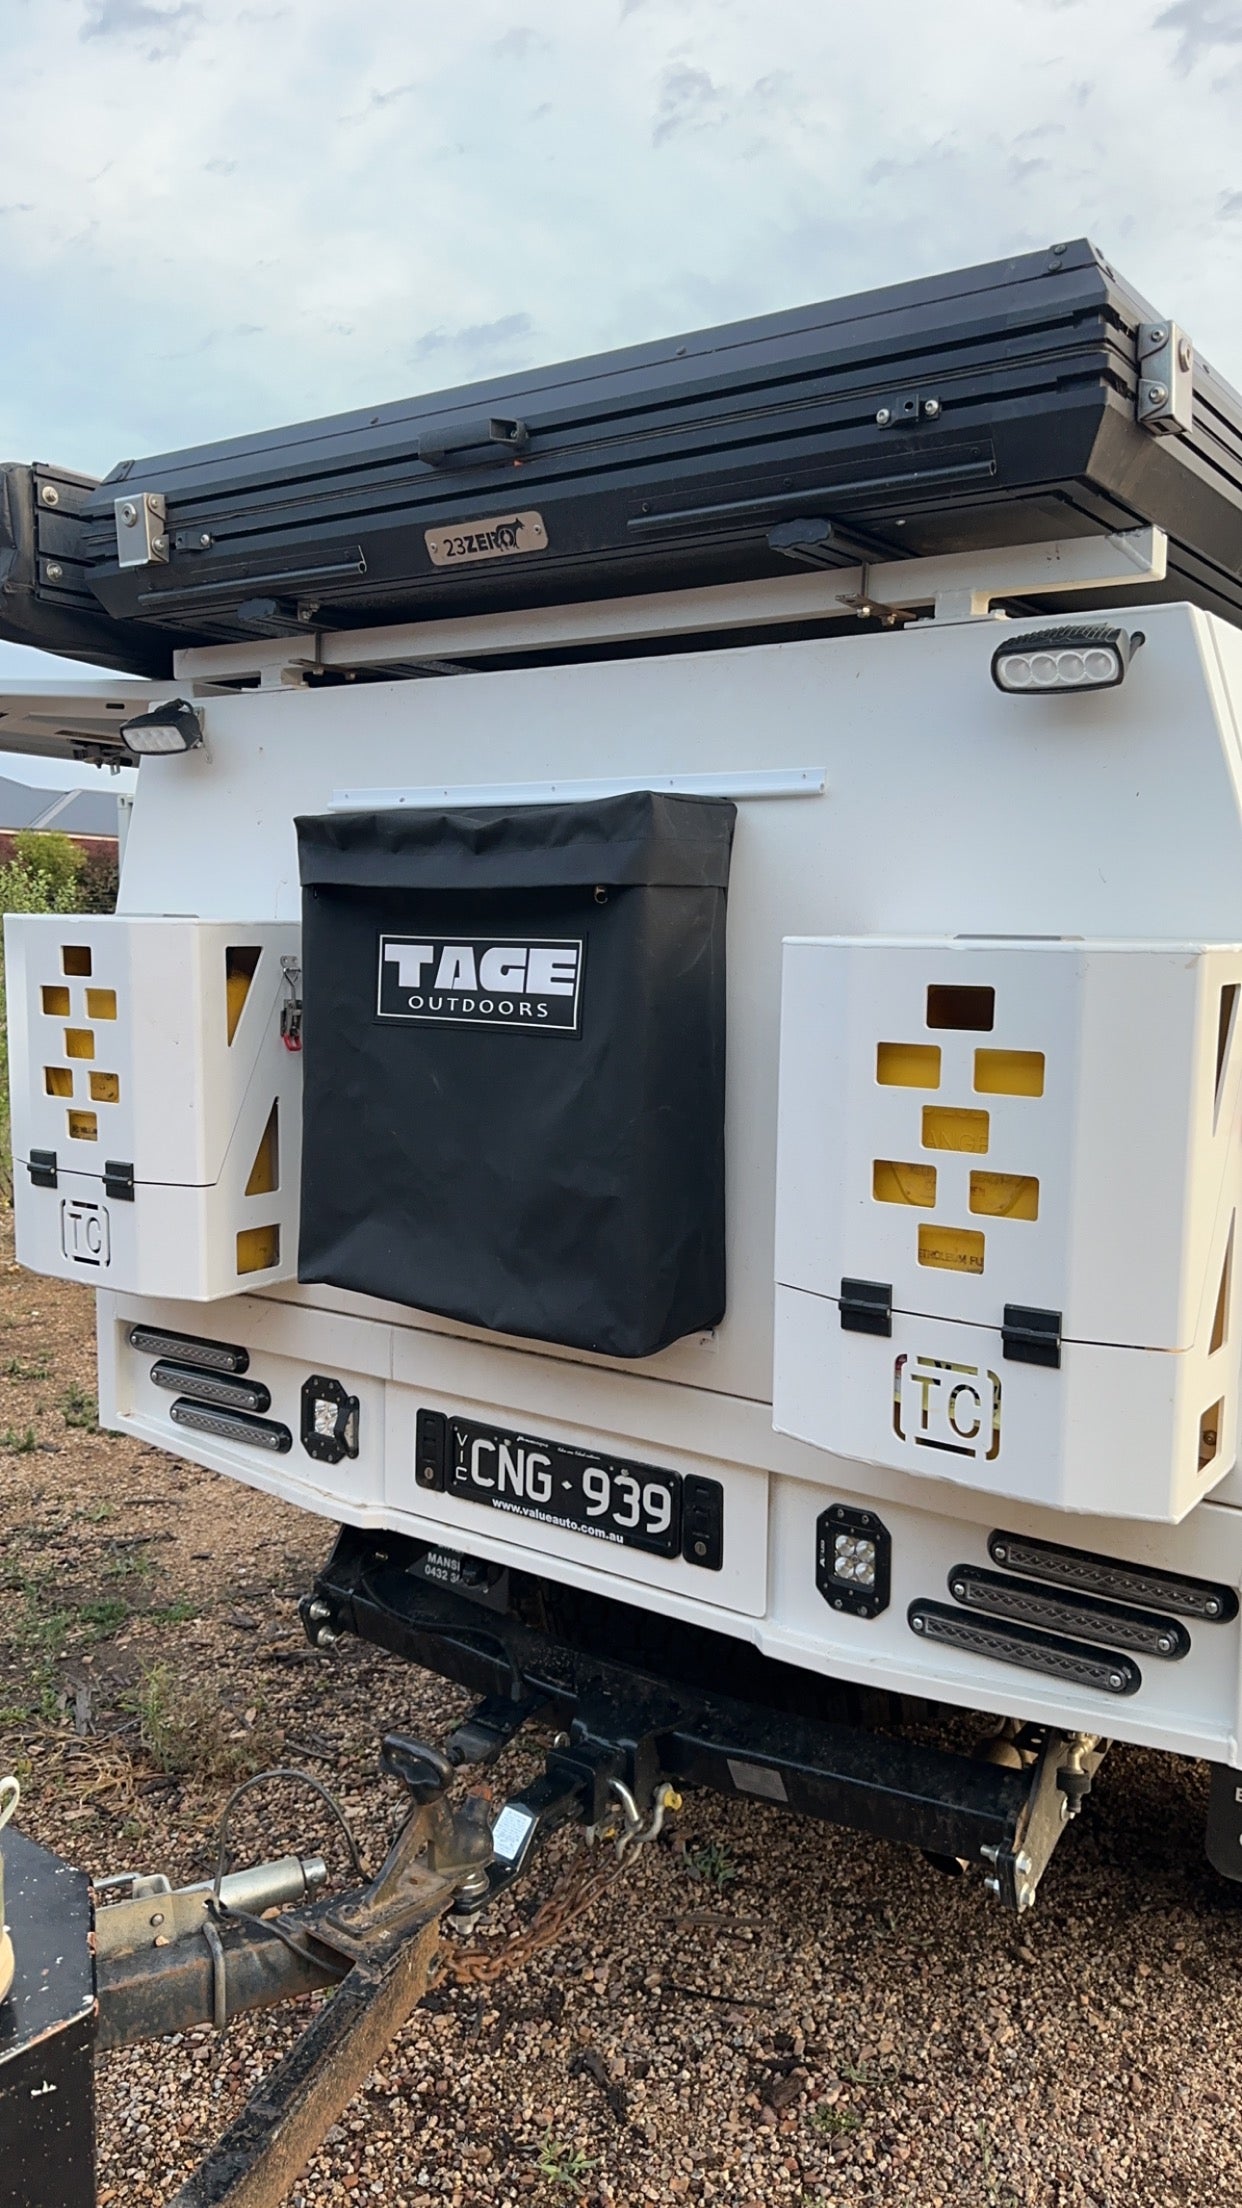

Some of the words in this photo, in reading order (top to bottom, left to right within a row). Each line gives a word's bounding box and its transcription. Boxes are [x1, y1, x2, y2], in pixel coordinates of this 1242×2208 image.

[443, 528, 514, 557] 23ZERO
[384, 943, 577, 997] TAGE
[408, 995, 549, 1018] OUTDOORS
[66, 1212, 102, 1254] TC
[909, 1373, 982, 1440] TC
[454, 1432, 468, 1481] VIC
[492, 1498, 624, 1544] www.valueauto.com.au
[424, 1564, 448, 1582] 0432
